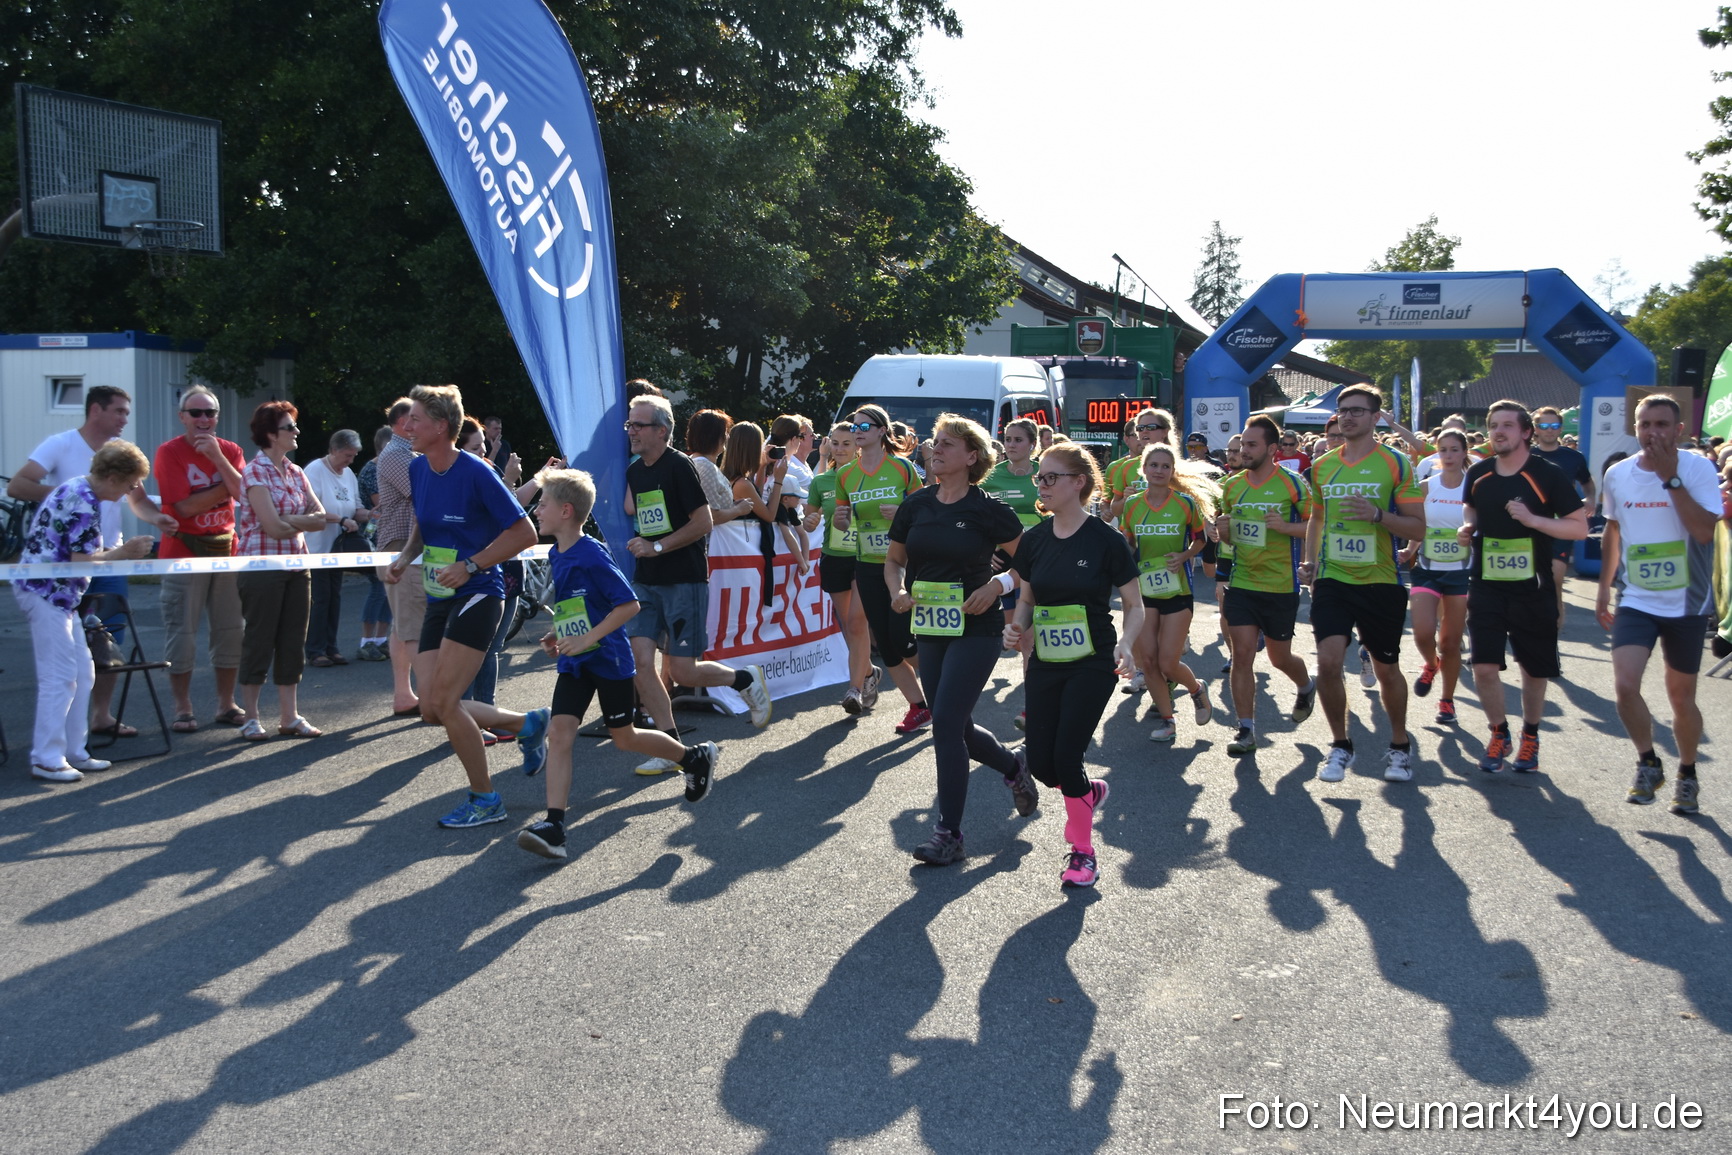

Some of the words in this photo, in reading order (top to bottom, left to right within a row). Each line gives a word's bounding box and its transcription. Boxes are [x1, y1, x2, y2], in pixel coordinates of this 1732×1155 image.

[1388, 305, 1473, 320] firmenlauf
[1234, 335, 1278, 344] Fischer
[849, 486, 898, 503] BOCK
[1321, 483, 1381, 499] BOCK
[638, 507, 664, 525] 1239
[1135, 524, 1180, 535] BOCK
[1235, 522, 1259, 538] 152
[1336, 537, 1366, 553] 140
[1433, 541, 1459, 554] 586
[1487, 555, 1528, 569] 1549
[1639, 561, 1676, 579] 579
[1146, 571, 1170, 587] 151
[914, 606, 961, 629] 5189
[557, 619, 589, 638] 1498
[1039, 627, 1085, 647] 1550
